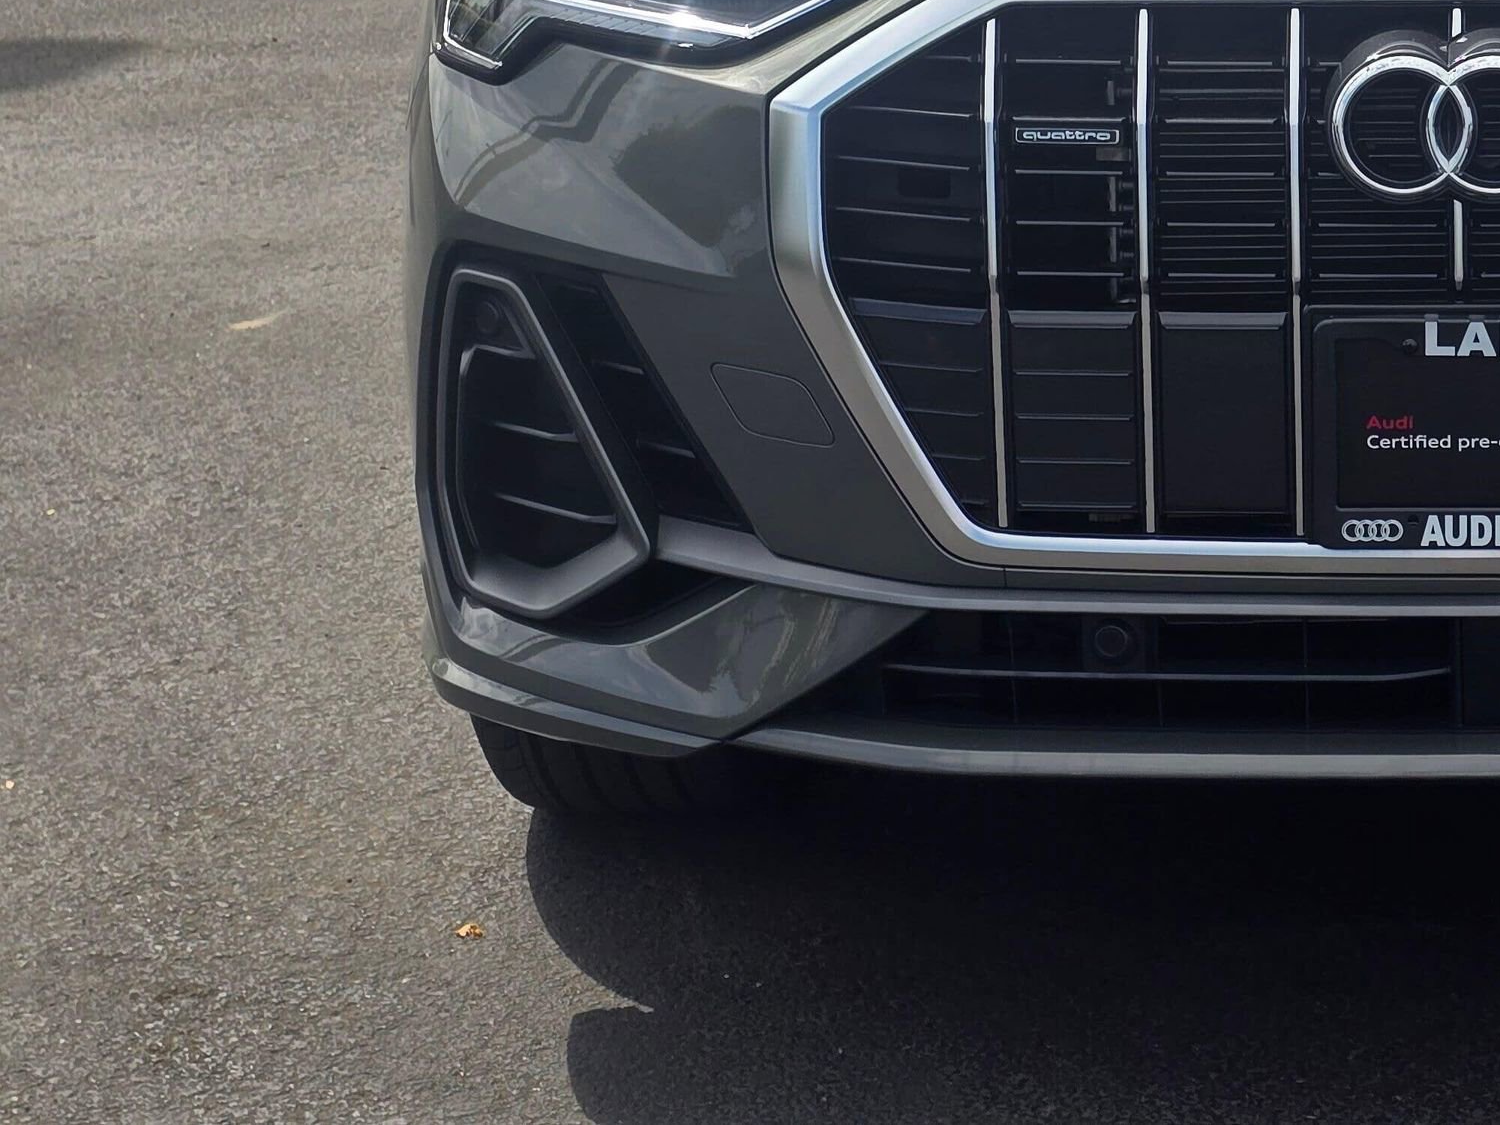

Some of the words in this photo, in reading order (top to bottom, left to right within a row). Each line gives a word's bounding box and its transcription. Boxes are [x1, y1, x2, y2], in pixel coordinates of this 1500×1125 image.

[1022, 130, 1111, 142] quattro
[1366, 415, 1414, 430] Audi
[1366, 434, 1452, 450] Certified
